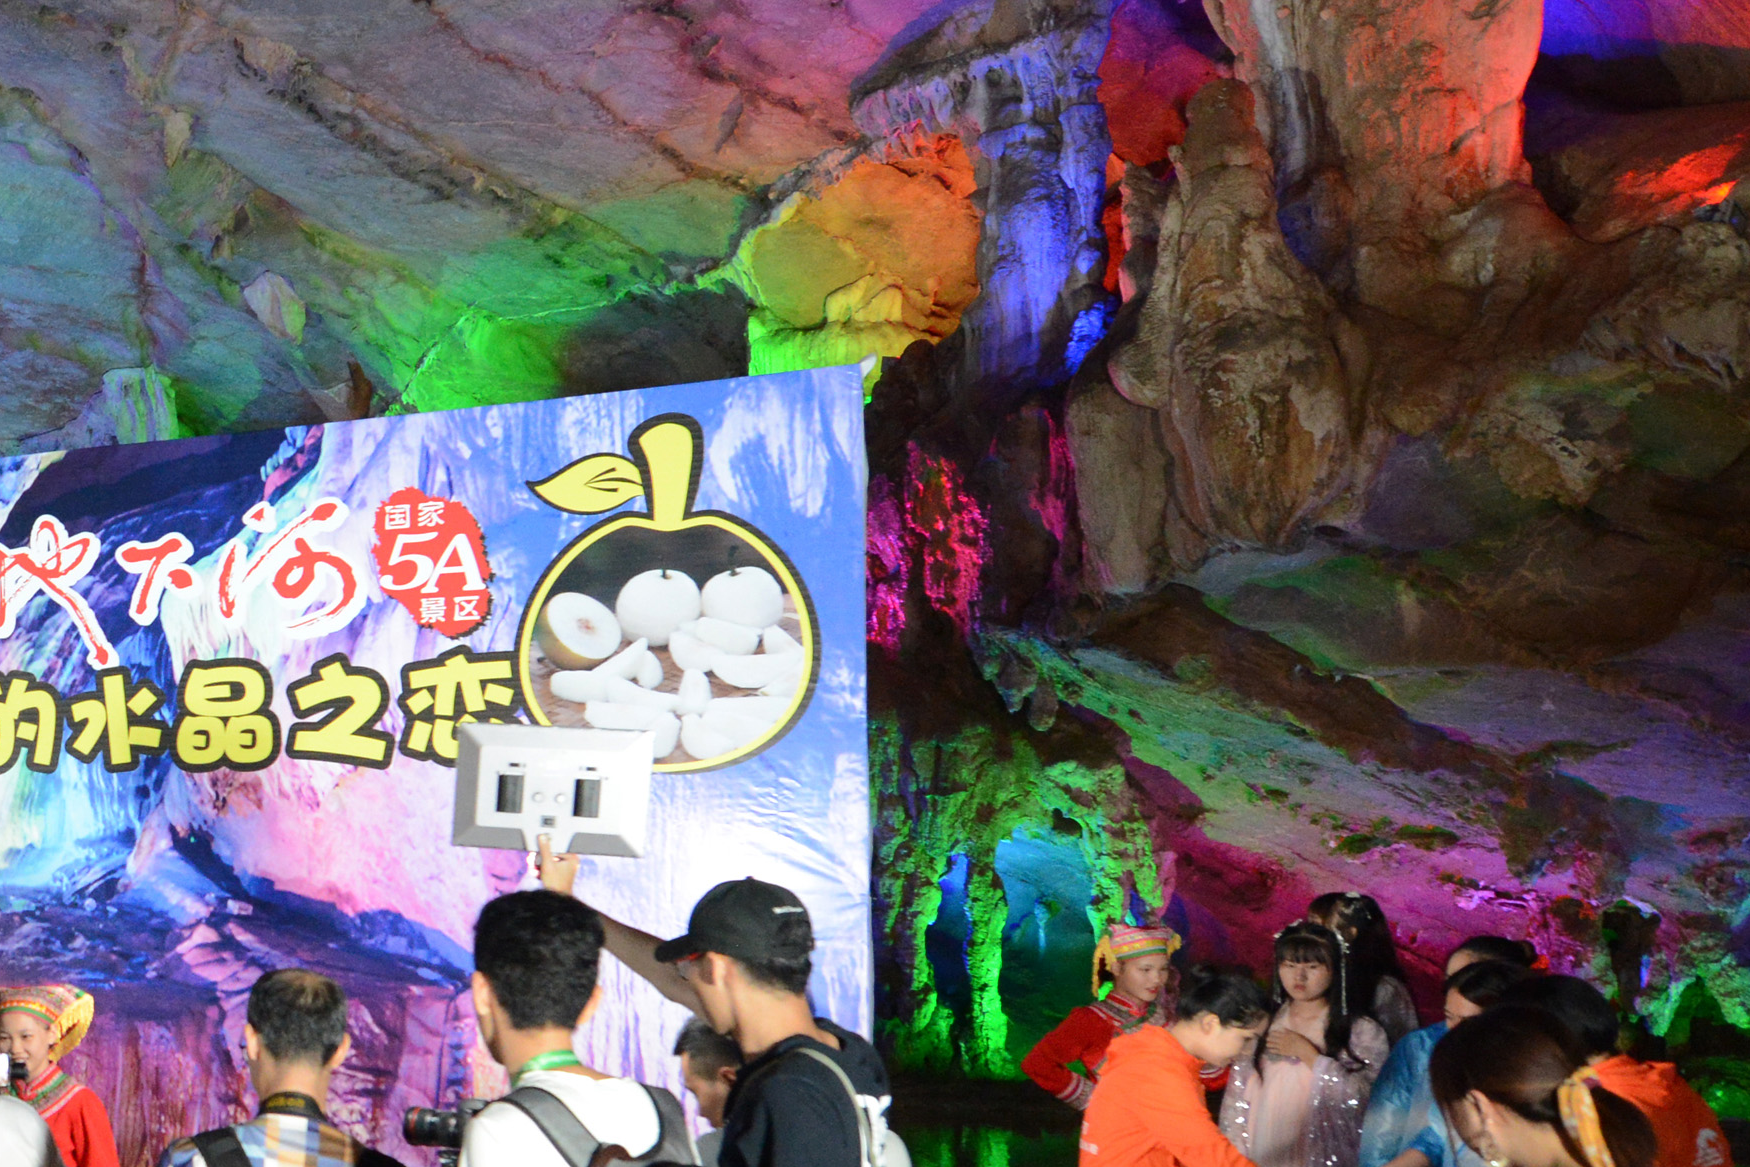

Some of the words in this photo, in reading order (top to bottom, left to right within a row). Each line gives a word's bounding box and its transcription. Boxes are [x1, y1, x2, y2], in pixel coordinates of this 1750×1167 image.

[384, 500, 445, 531] 国家
[379, 530, 487, 594] 5A
[419, 595, 481, 624] 景区
